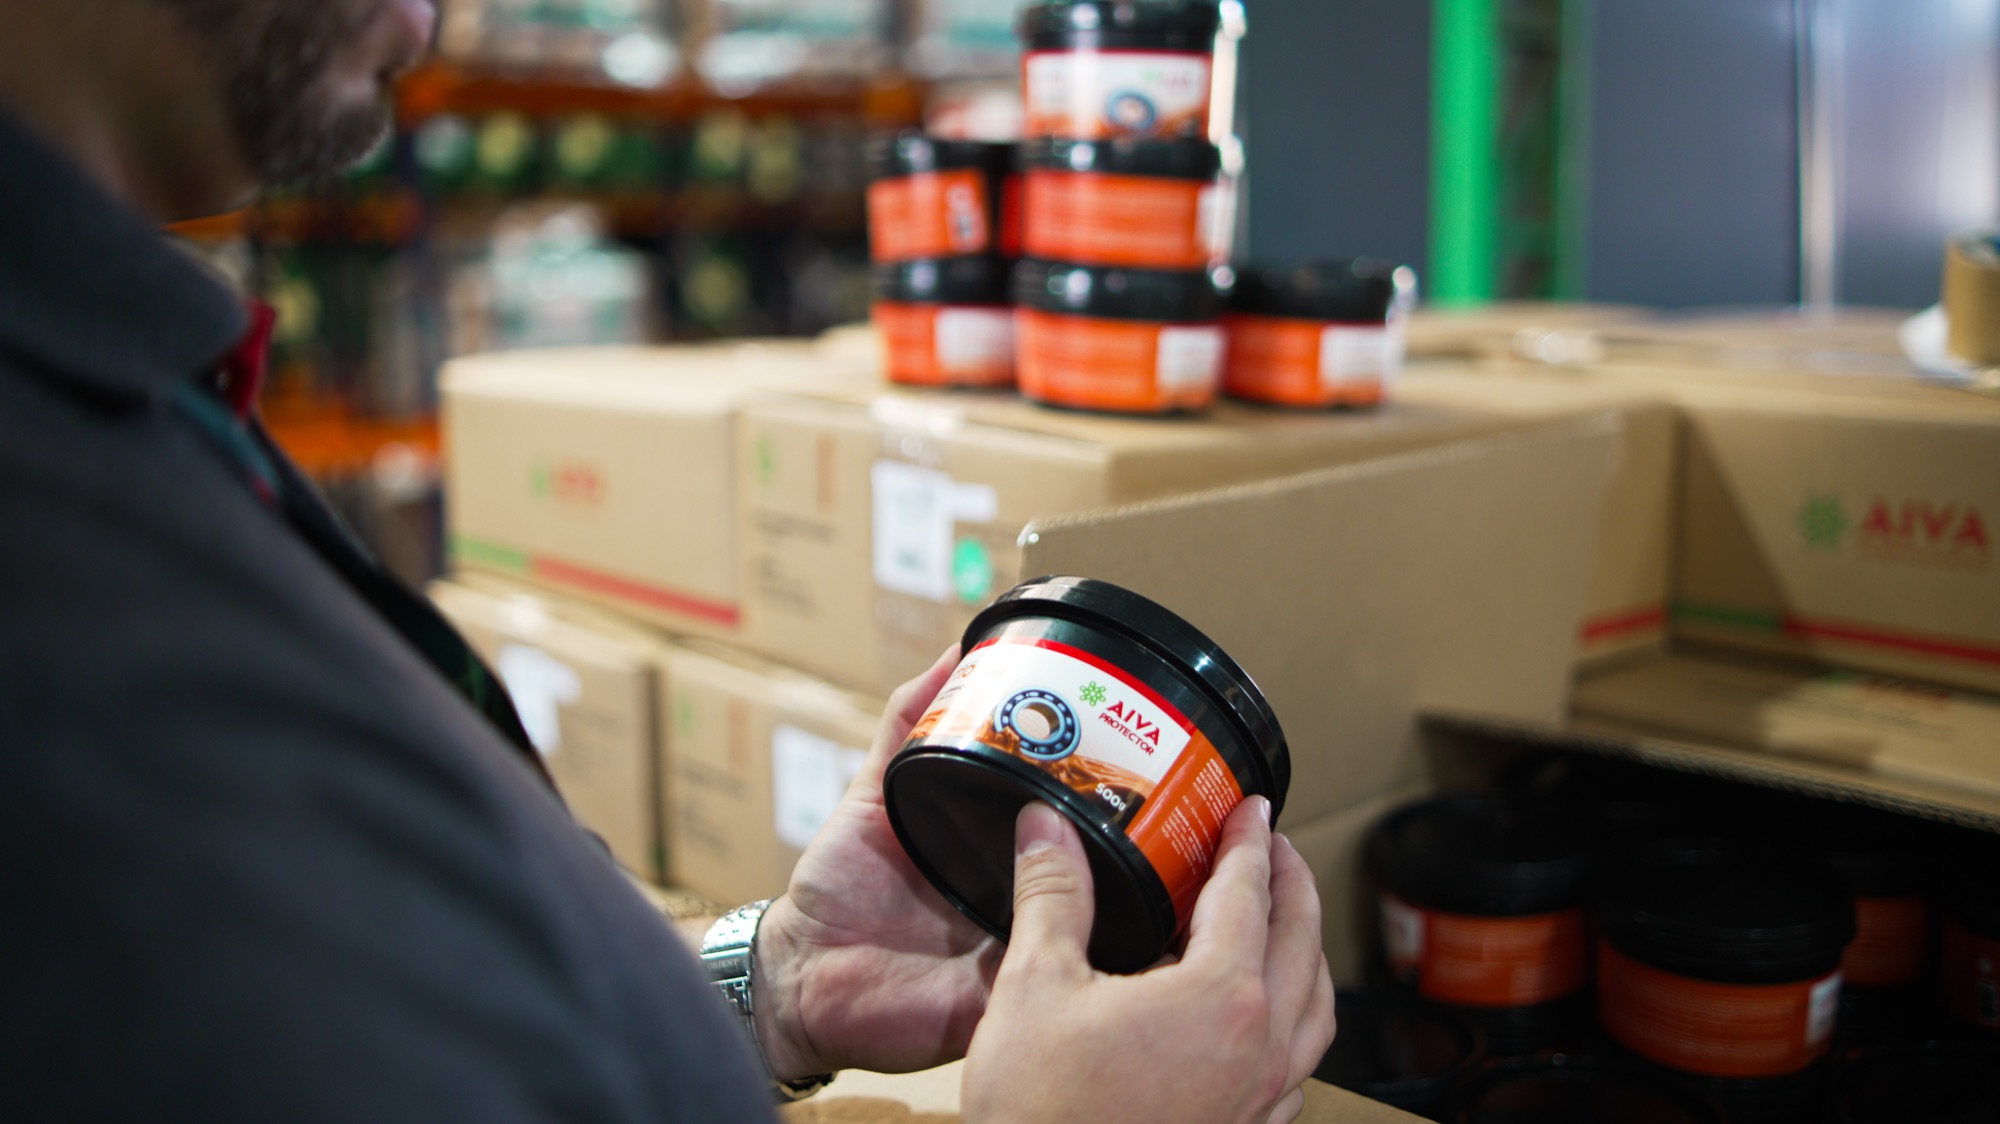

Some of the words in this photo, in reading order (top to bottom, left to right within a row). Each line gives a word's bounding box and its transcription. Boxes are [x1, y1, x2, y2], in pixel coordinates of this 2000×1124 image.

[1860, 497, 1989, 547] AIVA
[1099, 712, 1154, 756] PROTECTOR
[1106, 700, 1160, 747] AIVA
[1095, 783, 1126, 811] 500g
